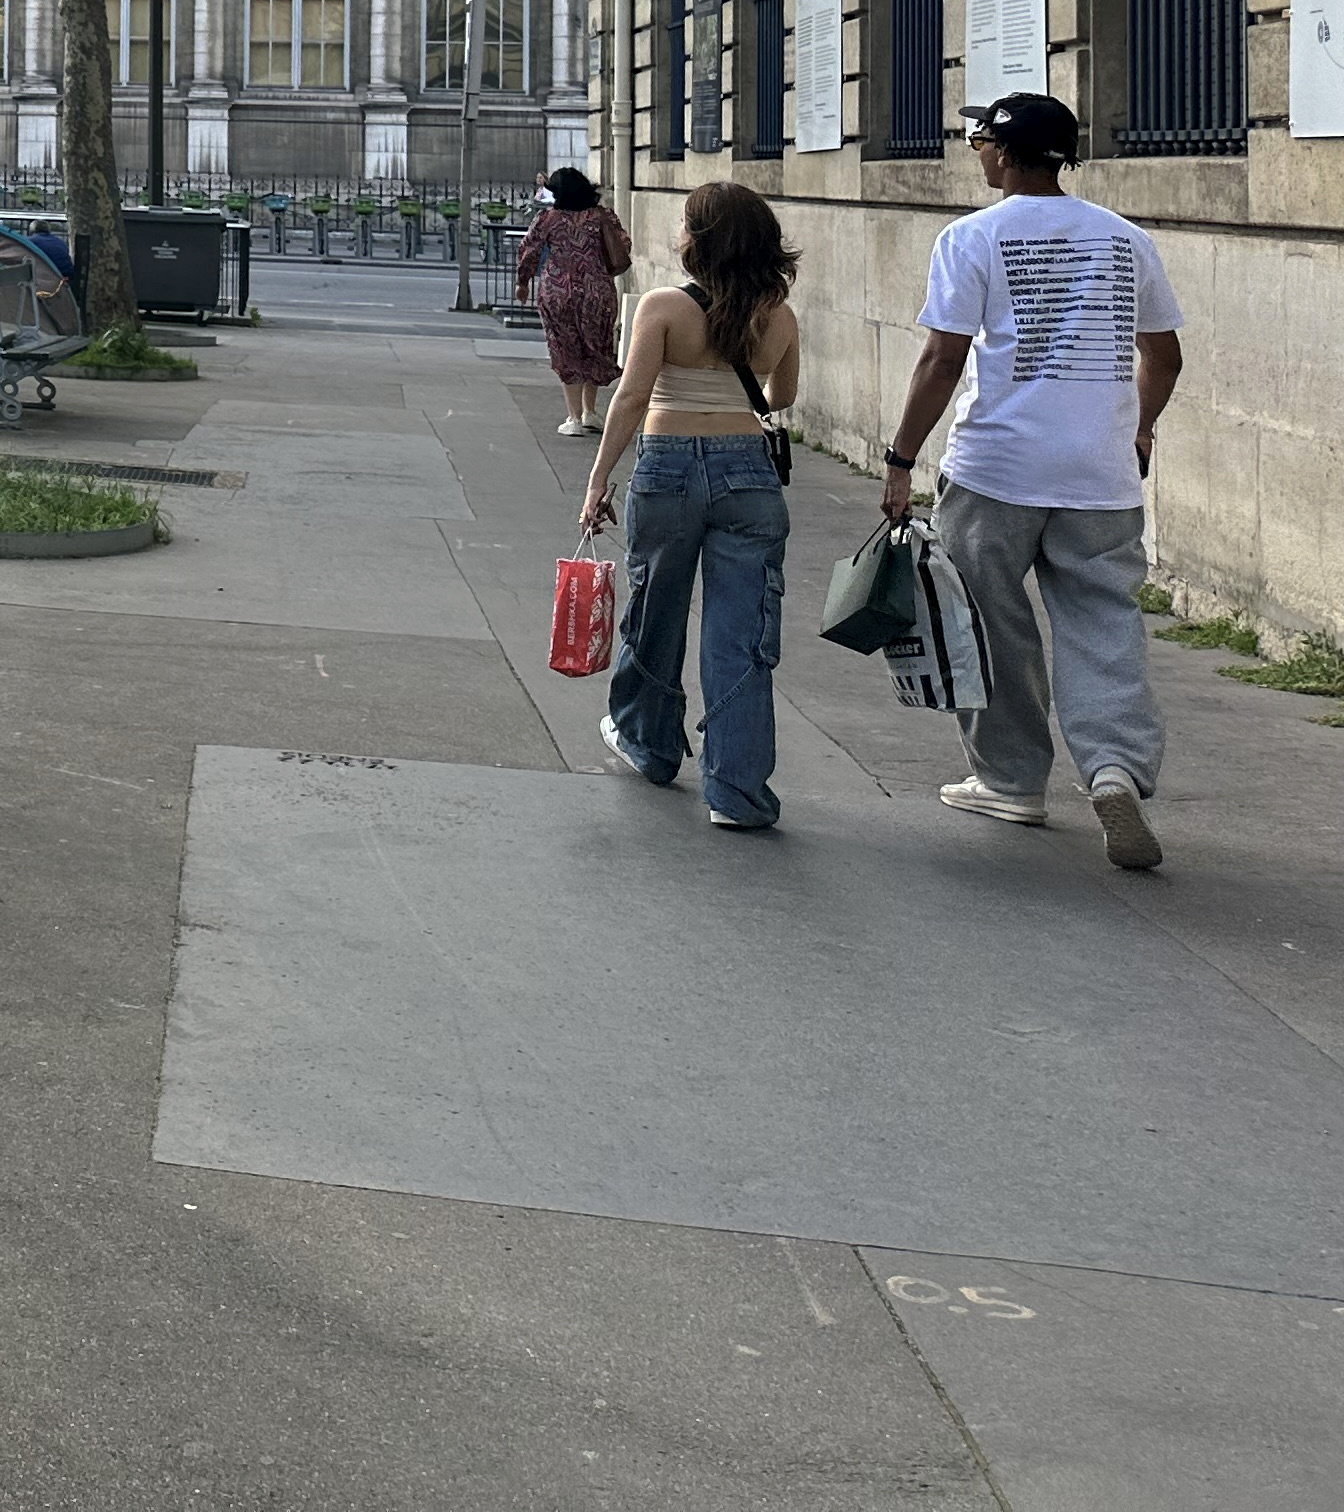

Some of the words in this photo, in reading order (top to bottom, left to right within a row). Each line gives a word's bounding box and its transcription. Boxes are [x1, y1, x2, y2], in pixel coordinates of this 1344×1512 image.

[999, 239, 1024, 247] PARIS
[1004, 257, 1054, 267] STRASBOURG
[1011, 297, 1035, 306] LYON
[567, 576, 578, 646] BERSHKA.COM
